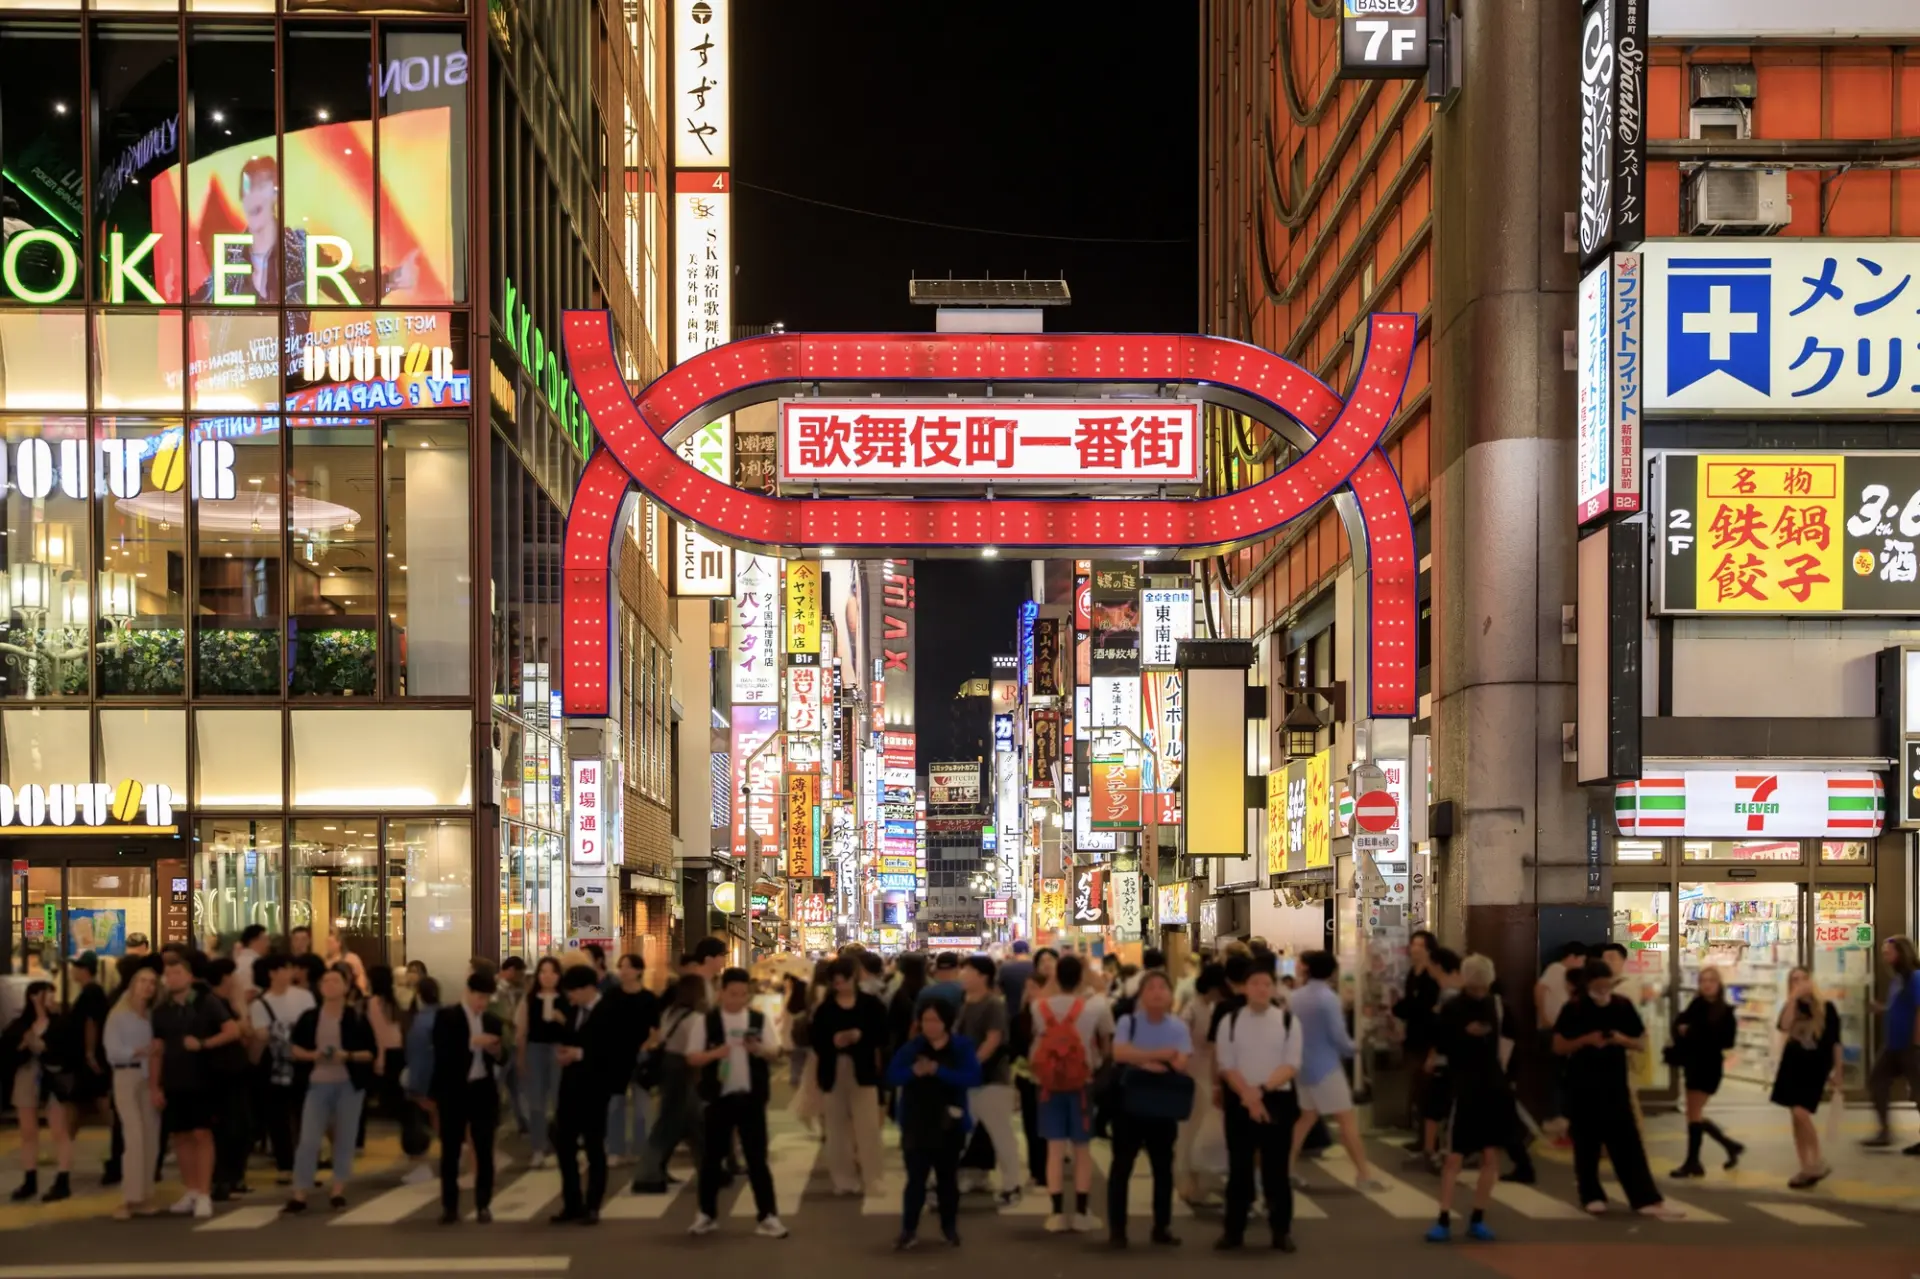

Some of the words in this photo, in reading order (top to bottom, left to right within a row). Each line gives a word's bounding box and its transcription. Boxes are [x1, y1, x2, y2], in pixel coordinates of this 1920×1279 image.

[1356, 21, 1416, 61] 7F
[687, 33, 717, 155] すずや
[1619, 37, 1644, 145] Sparkle
[712, 174, 724, 189] 4
[1620, 148, 1640, 225] スパークル
[3, 229, 362, 305] OKER
[1789, 257, 1920, 316] メン
[303, 342, 454, 382] DOUTOR
[1616, 278, 1637, 421] ファイトフィット
[1788, 336, 1920, 398] クリ
[0, 433, 236, 500] OUTOR
[798, 414, 1183, 469] 歌舞伎町一番街
[1621, 425, 1633, 489] 新宿東口駅前
[1616, 496, 1636, 508] B2F
[1732, 467, 1812, 495] 名物
[1668, 509, 1694, 556] 2F
[1708, 503, 1831, 552] 鉄鍋
[1708, 552, 1831, 603] 餃子
[1855, 556, 1872, 572] 365
[737, 592, 760, 672] バンタイ
[793, 581, 806, 649] ヤマネ肉店
[1155, 605, 1171, 662] 東南荘
[795, 654, 813, 664] B1F
[746, 690, 763, 700] 3F
[759, 707, 777, 721] 2F
[1165, 675, 1182, 757] ハイボール
[579, 768, 596, 854] 劇場通り
[1105, 765, 1129, 820] ステップ
[1734, 803, 1780, 814] ELEVEN
[1735, 775, 1778, 831] 7
[1357, 836, 1396, 849] 自転車を除く
[1590, 872, 1600, 881] 17
[1822, 891, 1863, 900] ATM
[1816, 926, 1850, 941] たばこ
[1856, 927, 1871, 941] 酒
